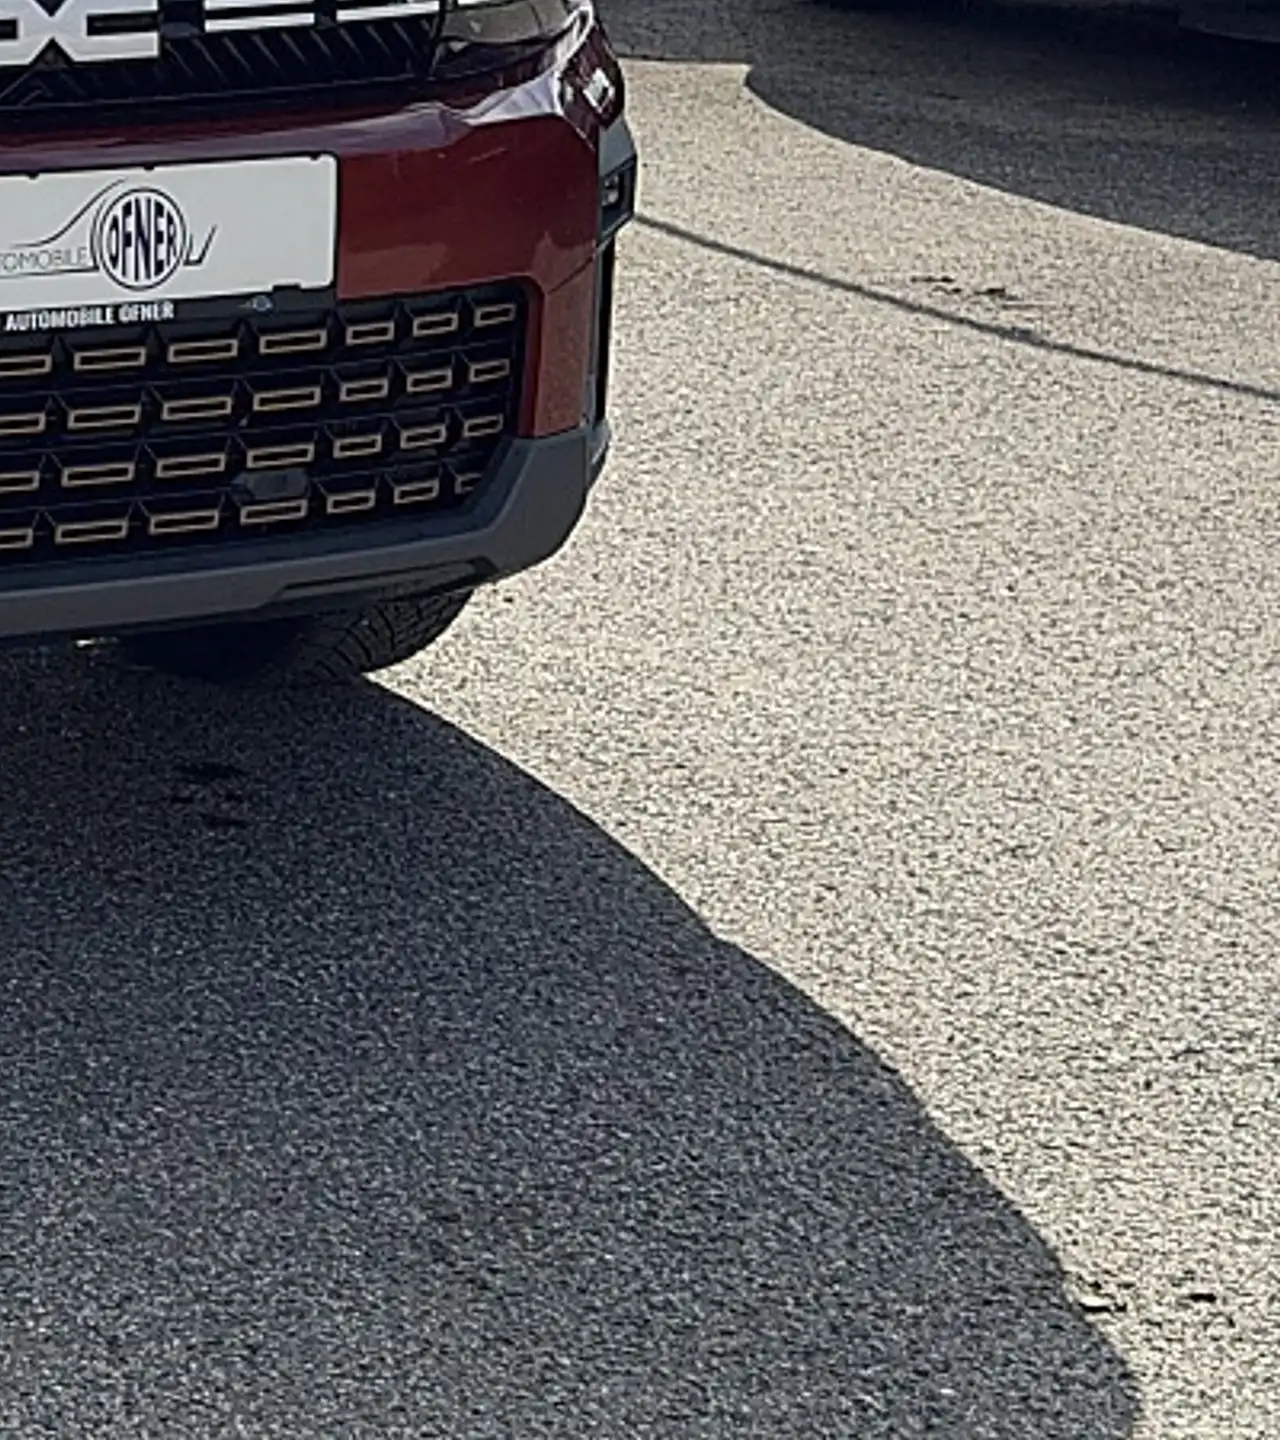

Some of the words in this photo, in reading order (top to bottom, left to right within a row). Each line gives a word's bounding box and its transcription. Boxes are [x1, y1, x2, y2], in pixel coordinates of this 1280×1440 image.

[108, 197, 177, 281] OFNER
[5, 306, 114, 331] AUTOMOBILE
[120, 301, 175, 320] OFNER
